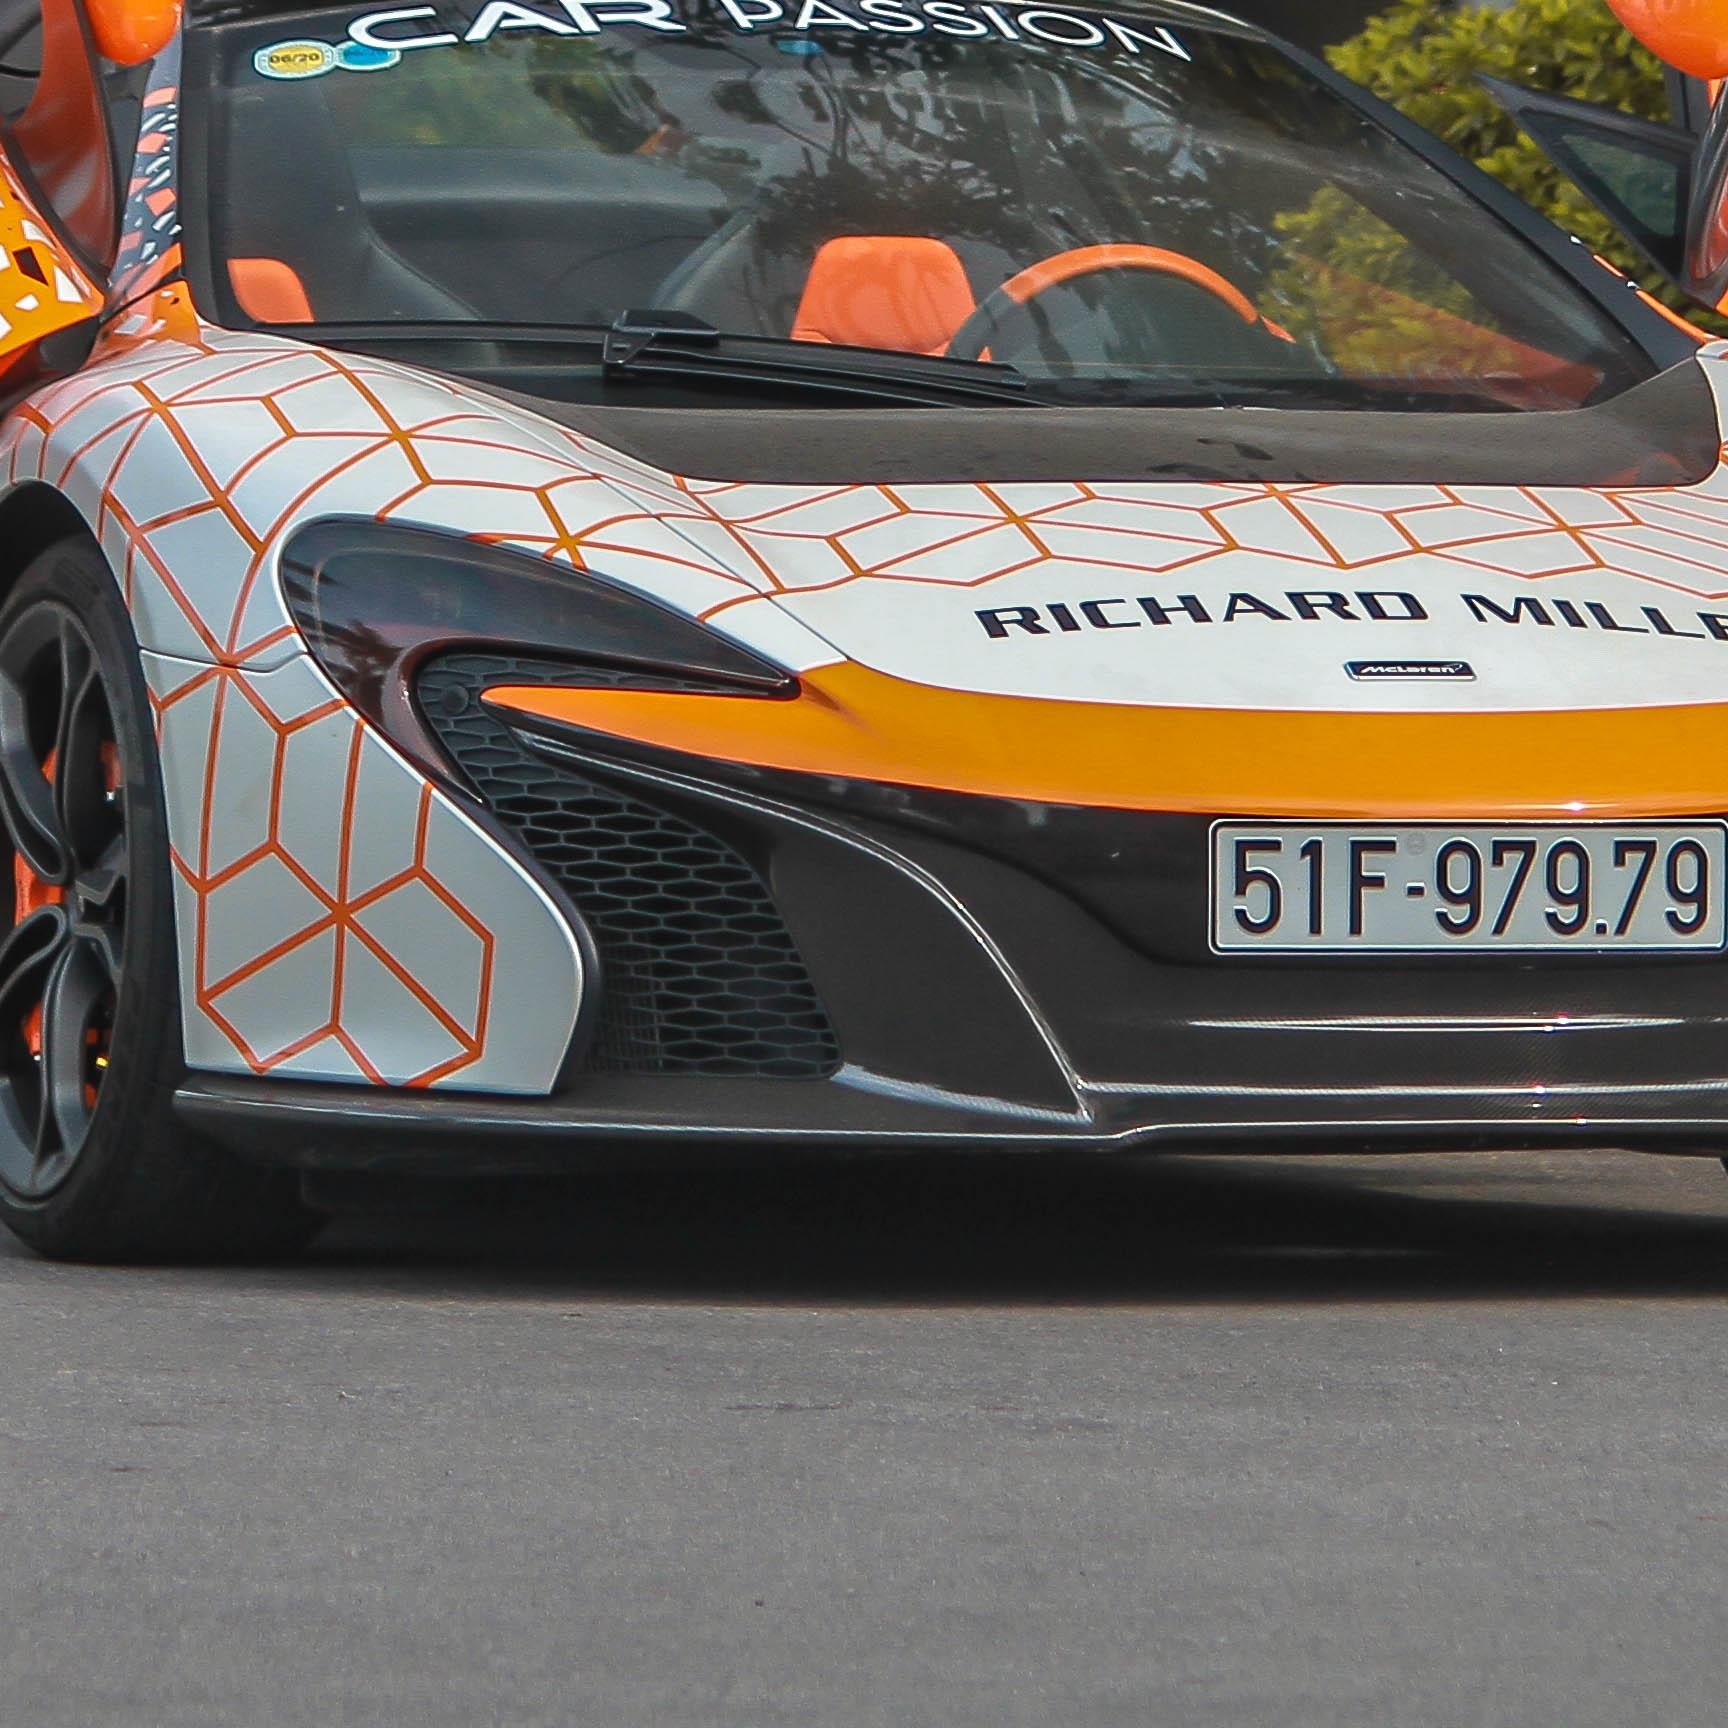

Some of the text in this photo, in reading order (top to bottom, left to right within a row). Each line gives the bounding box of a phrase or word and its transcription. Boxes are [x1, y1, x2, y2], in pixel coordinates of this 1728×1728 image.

[974, 591, 1430, 639] RICHARD
[1360, 664, 1462, 674] McLaren
[1232, 838, 1709, 936] 51F-979.79
